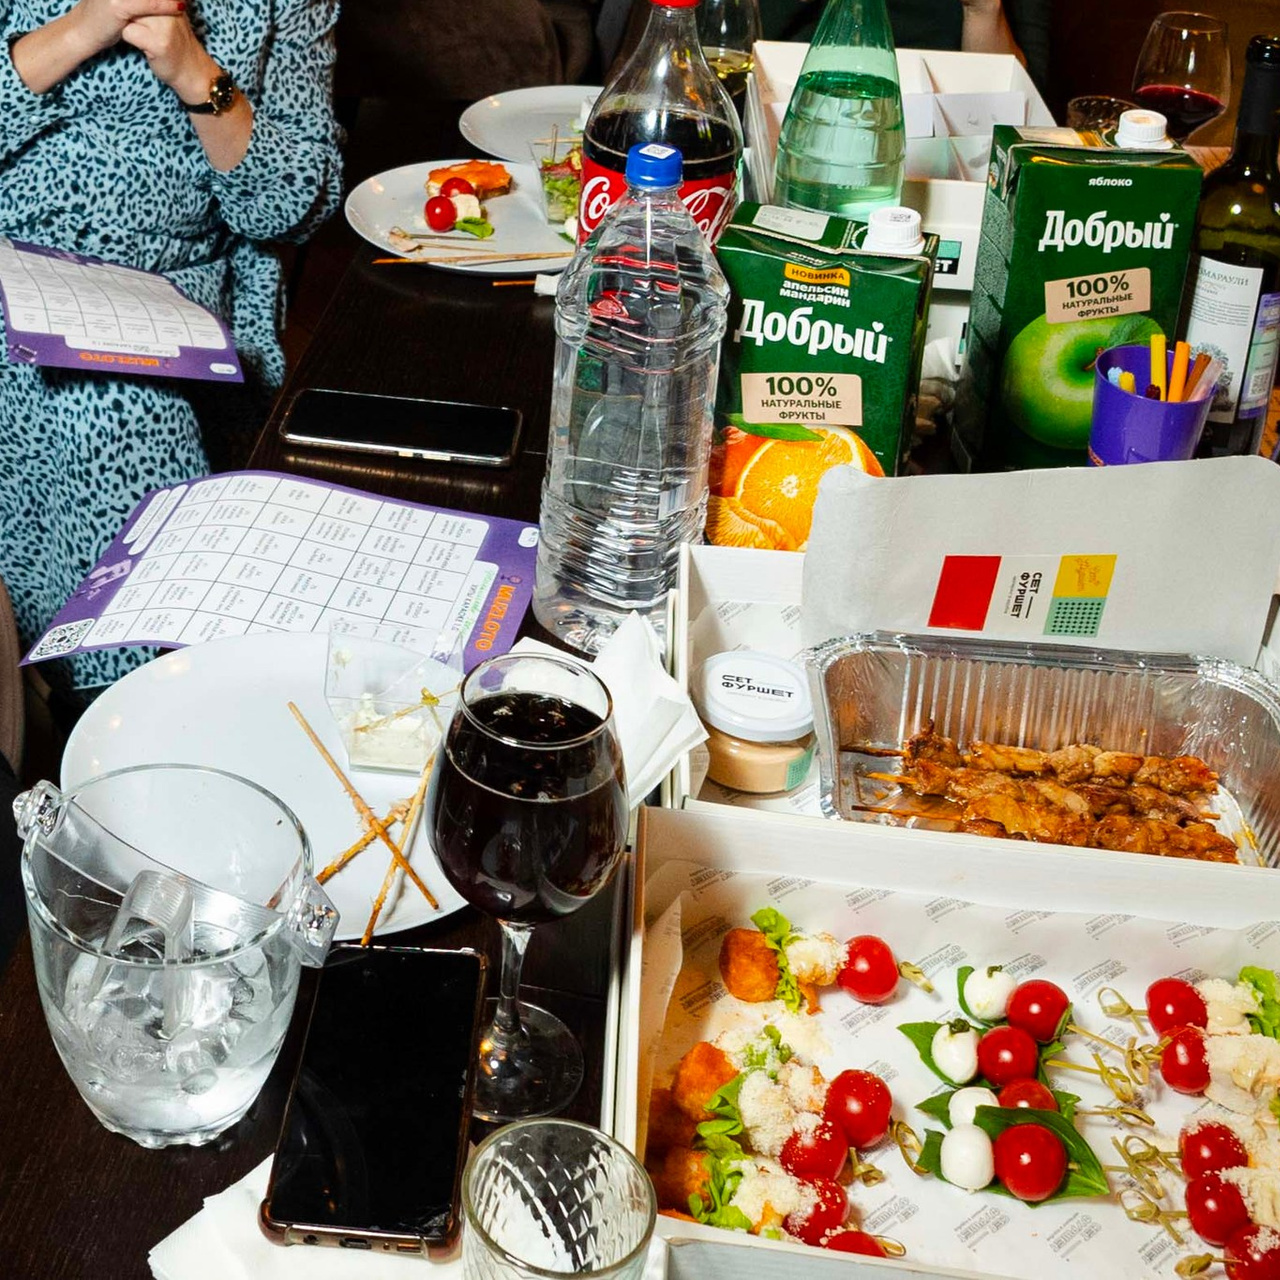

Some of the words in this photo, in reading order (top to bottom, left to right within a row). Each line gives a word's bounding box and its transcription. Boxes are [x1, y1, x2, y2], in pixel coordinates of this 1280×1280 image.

[1088, 176, 1133, 187] яблоко
[1037, 210, 1174, 253] Добрый
[791, 267, 845, 281] НОВИНКА
[782, 280, 850, 298] апельсин
[1066, 273, 1130, 298] 100%
[779, 288, 851, 308] мандарин
[1062, 292, 1134, 310] НАТУРАЛЬНЫЕ
[1077, 306, 1120, 318] ФРУКТЫ
[733, 299, 887, 364] Добрый
[765, 376, 838, 397] 100%
[761, 399, 842, 409] НАТУРАЛЬНЫЕ
[778, 410, 826, 421] ФРУКТЫ
[1028, 572, 1043, 595] СЕТ
[1010, 572, 1031, 619] ФУРШЕТ
[475, 584, 517, 651] MUZLOTO
[721, 674, 754, 684] СЕТ
[721, 681, 795, 698] ФУРШЕТ
